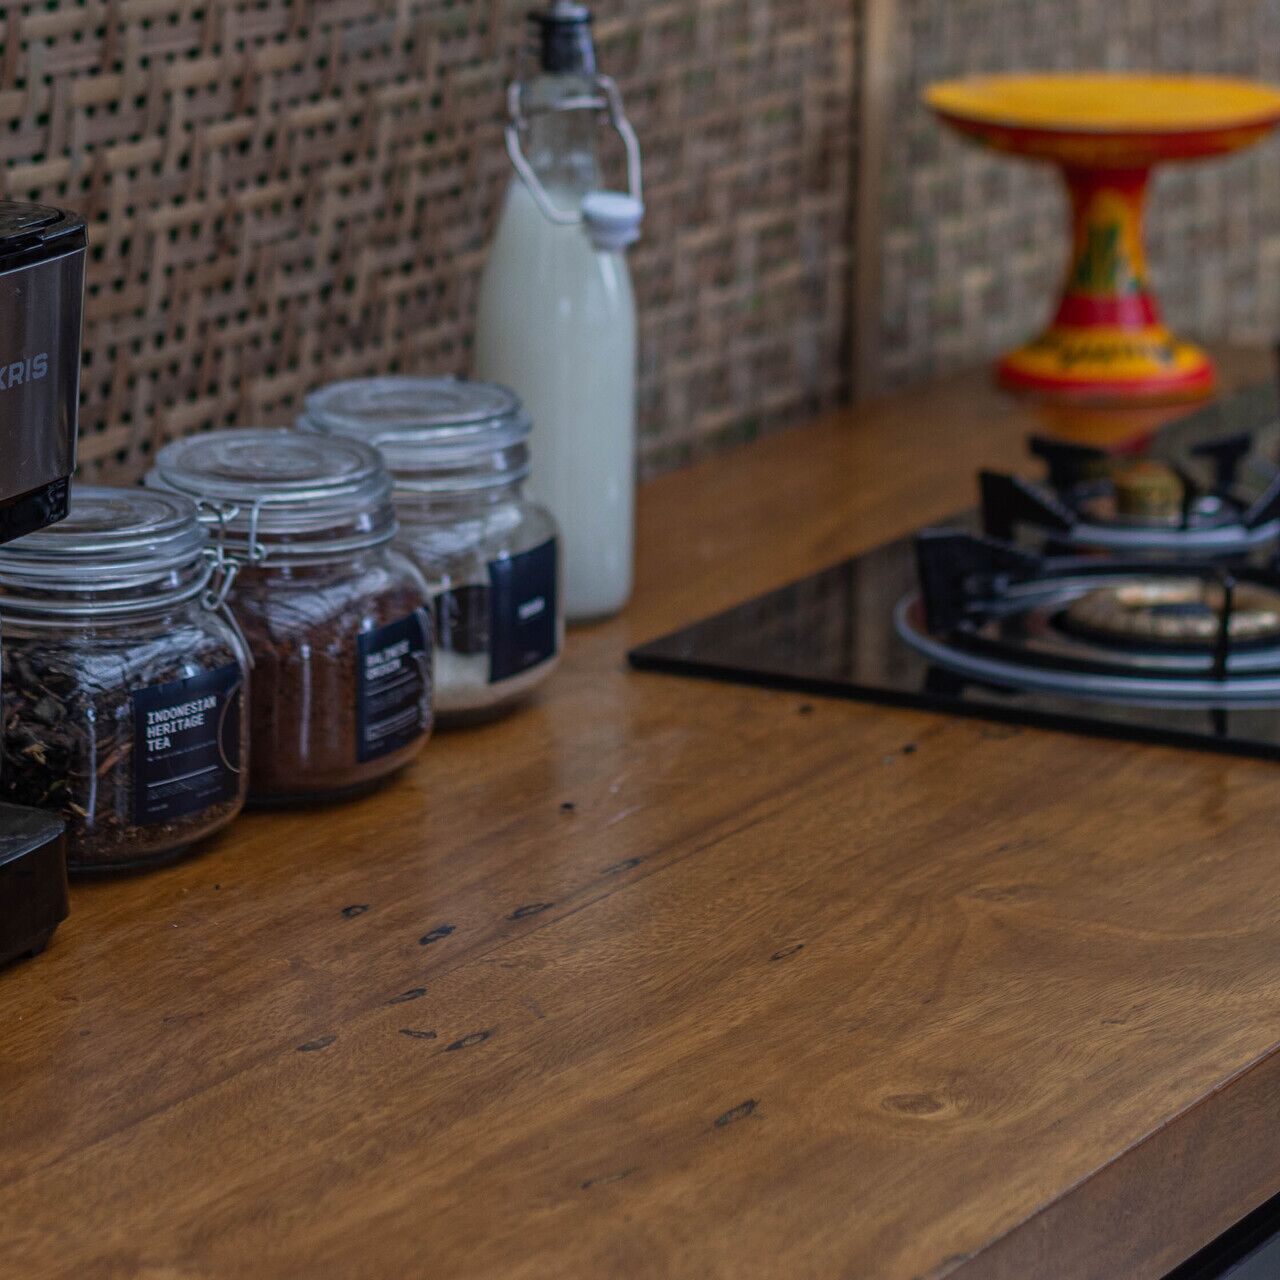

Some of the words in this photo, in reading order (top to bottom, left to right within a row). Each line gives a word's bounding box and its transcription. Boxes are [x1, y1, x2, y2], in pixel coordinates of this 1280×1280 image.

[147, 695, 217, 725] INDONESIAN
[146, 712, 205, 739] HERITAGE
[146, 736, 171, 752] TEA
